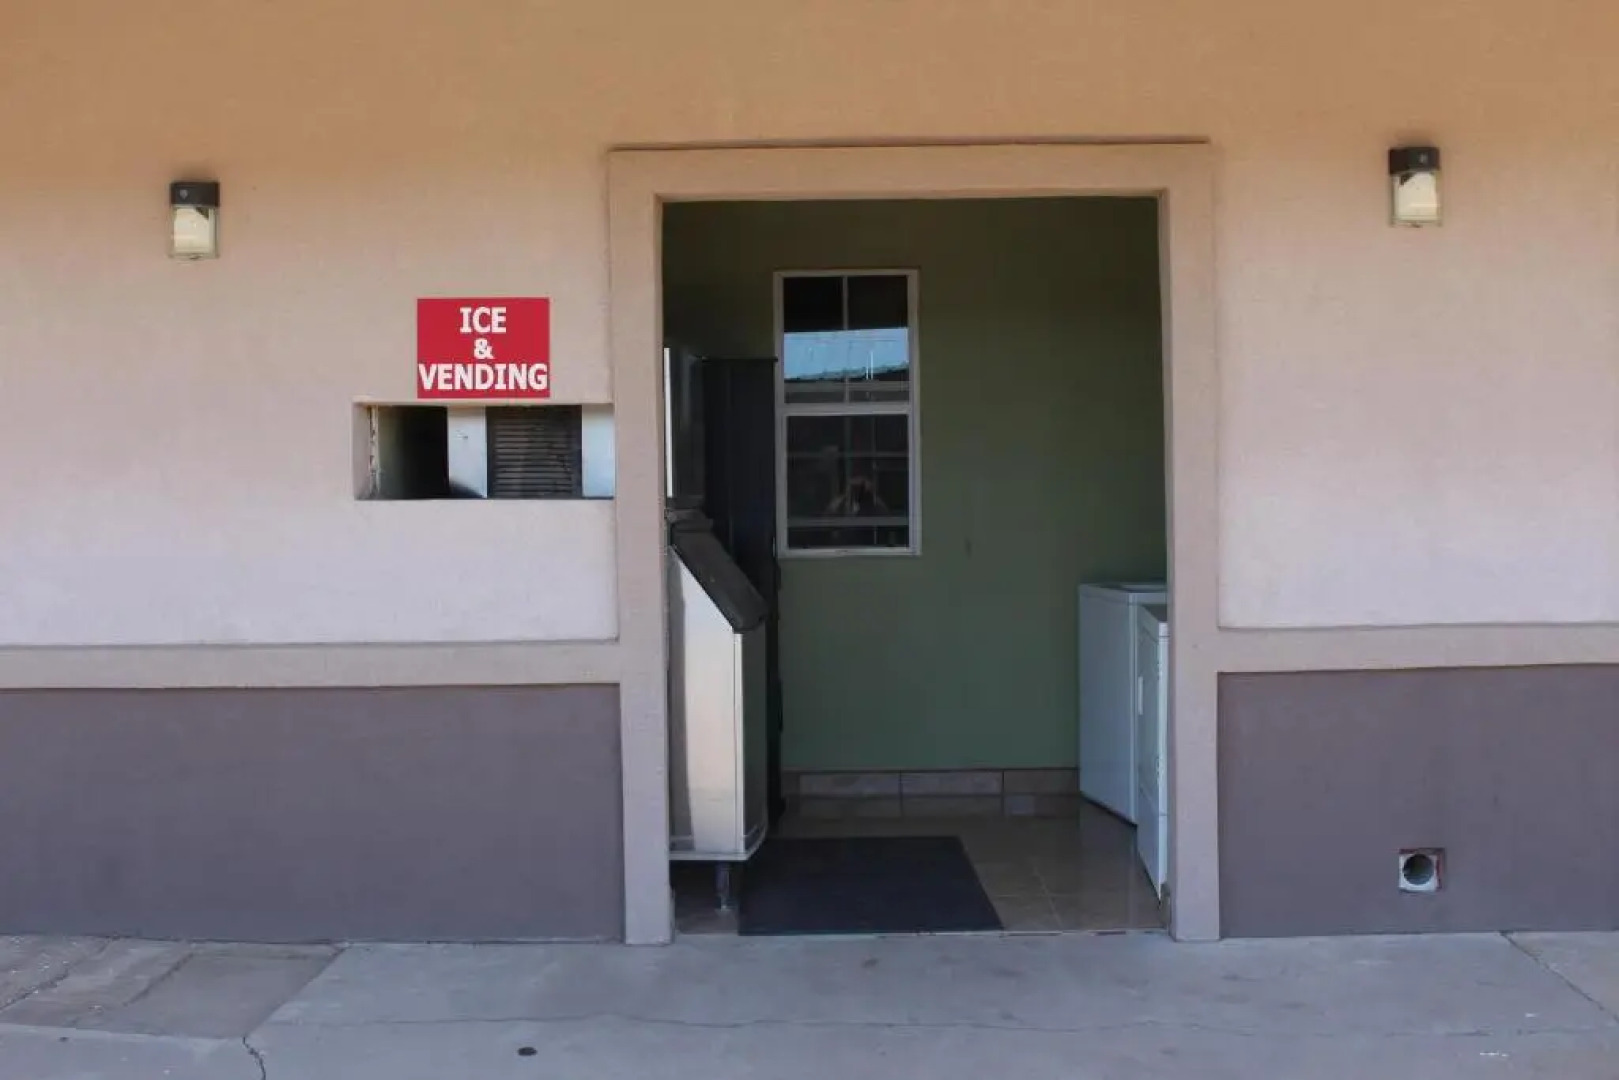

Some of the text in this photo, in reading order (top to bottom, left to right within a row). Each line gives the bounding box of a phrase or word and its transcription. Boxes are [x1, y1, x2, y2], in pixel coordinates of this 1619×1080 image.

[459, 306, 507, 334] ICE
[473, 338, 494, 360] &
[418, 363, 548, 390] VENDING
